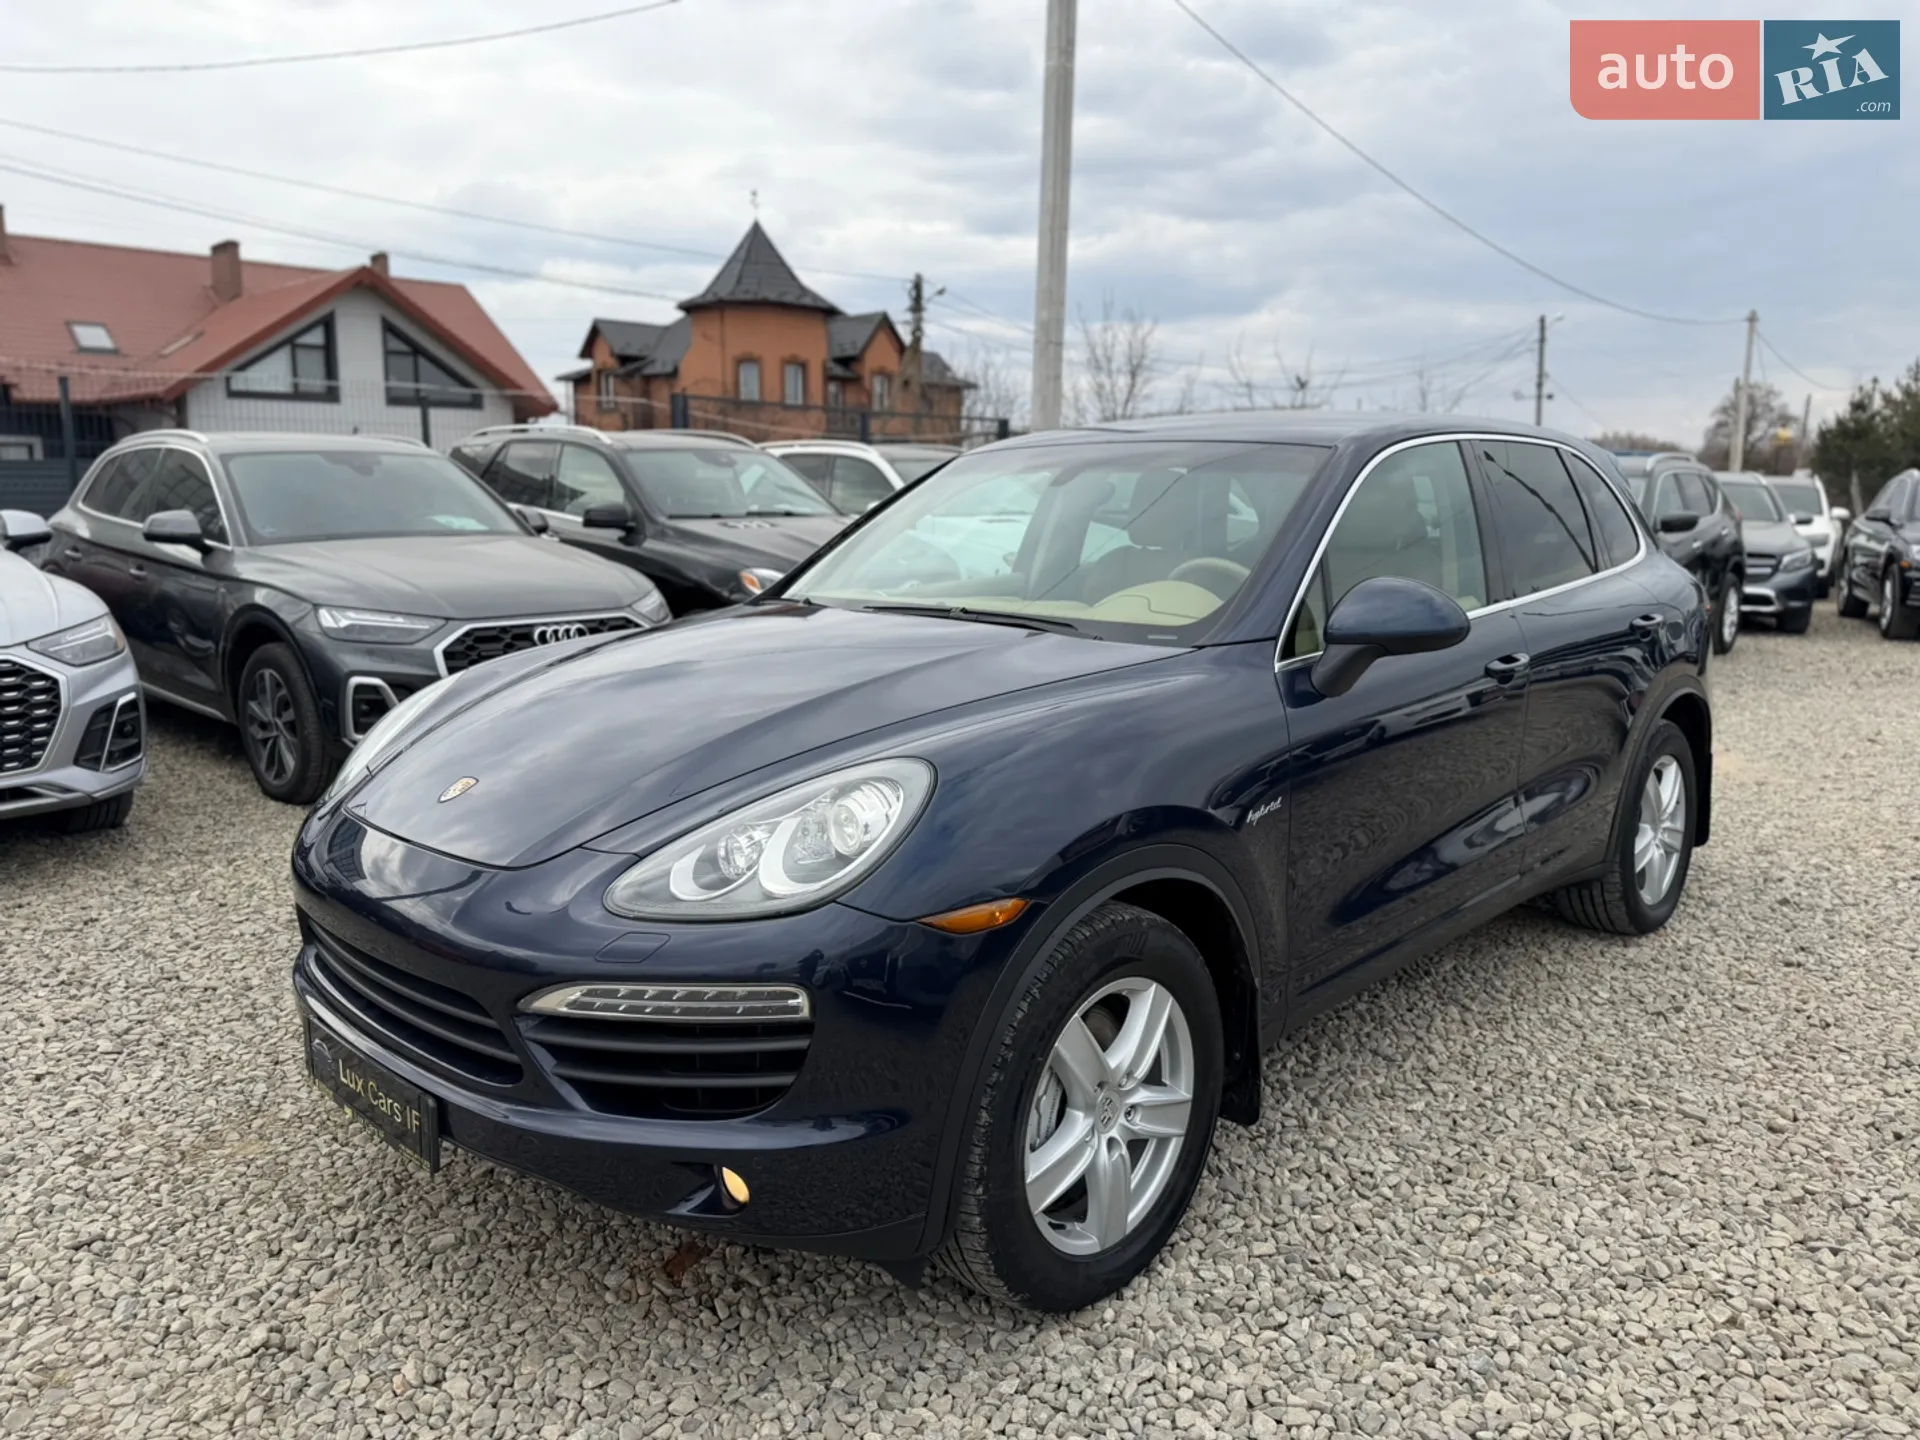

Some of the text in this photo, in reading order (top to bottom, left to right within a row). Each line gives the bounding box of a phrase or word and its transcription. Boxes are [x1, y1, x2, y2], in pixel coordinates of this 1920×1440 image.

[1246, 796, 1283, 827] hybrid
[338, 1058, 365, 1097] Lux
[367, 1081, 403, 1123] Cars
[406, 1105, 421, 1133] IF
